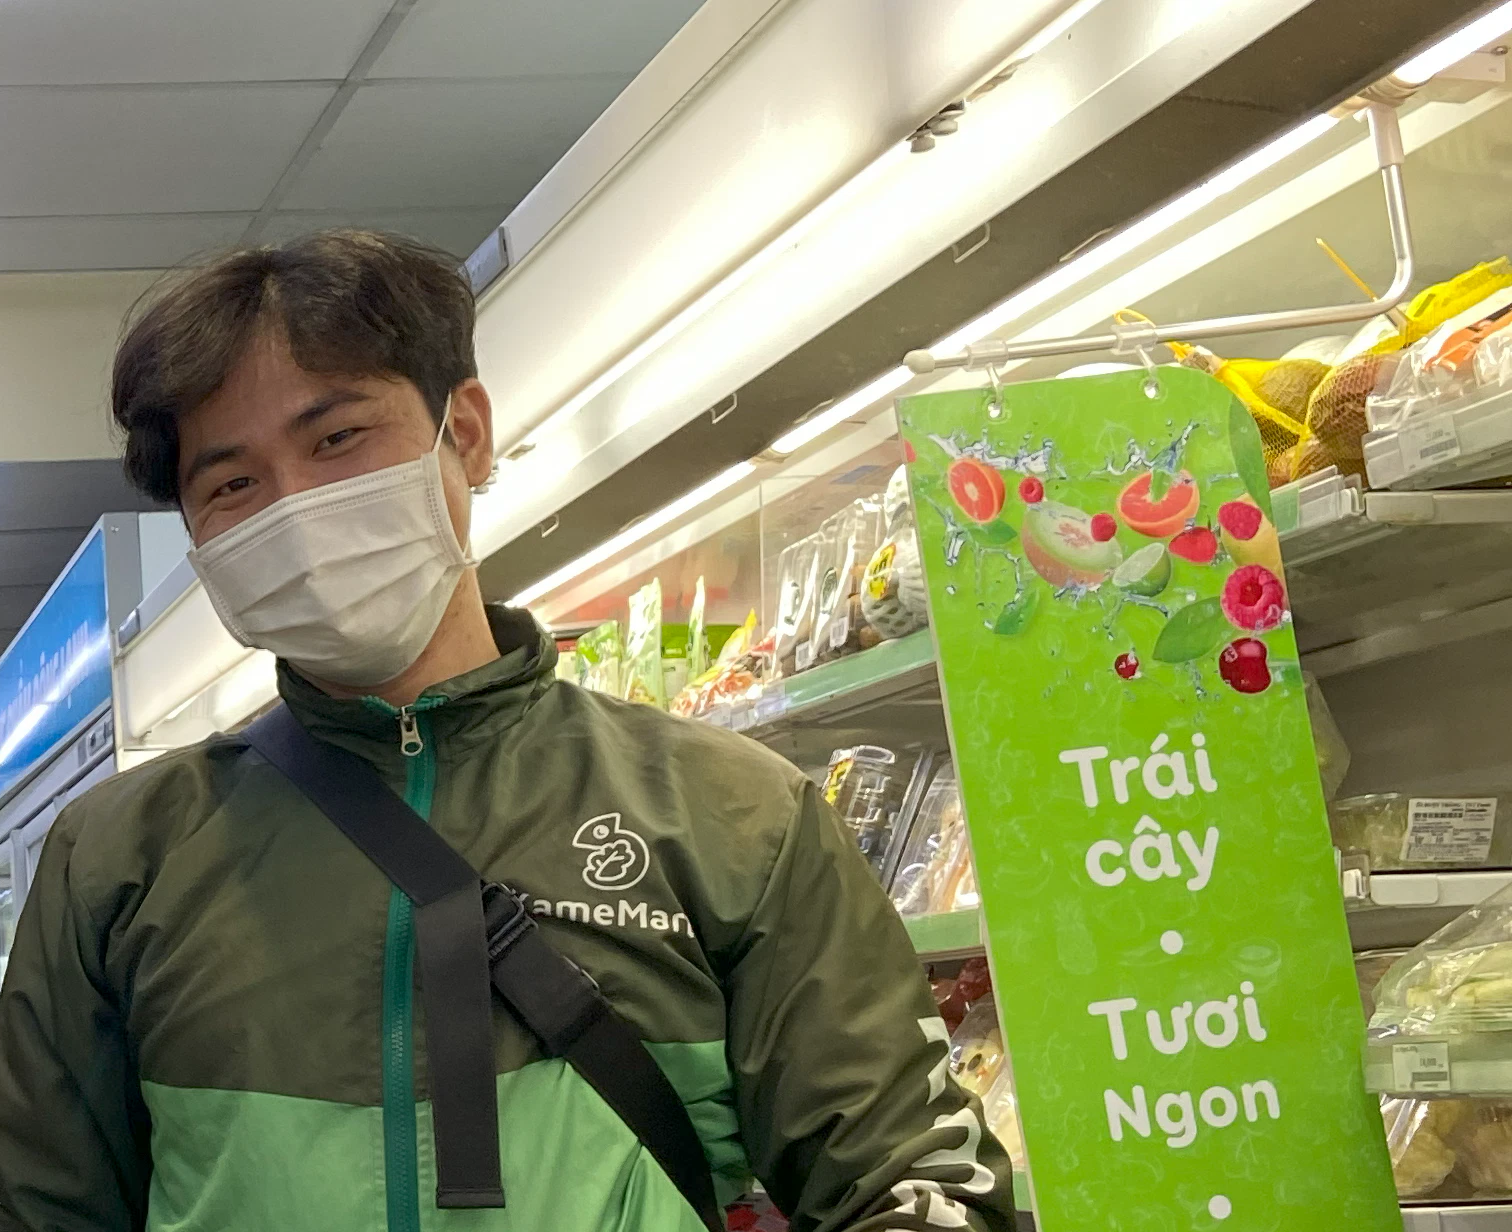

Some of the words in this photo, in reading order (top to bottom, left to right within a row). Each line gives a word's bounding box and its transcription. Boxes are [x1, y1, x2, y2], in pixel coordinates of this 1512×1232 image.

[1059, 732, 1219, 809] Trái
[1084, 814, 1220, 892] cây
[519, 893, 696, 938] ameMan
[1088, 981, 1268, 1061] Tươi
[1104, 1079, 1281, 1148] Ngon
